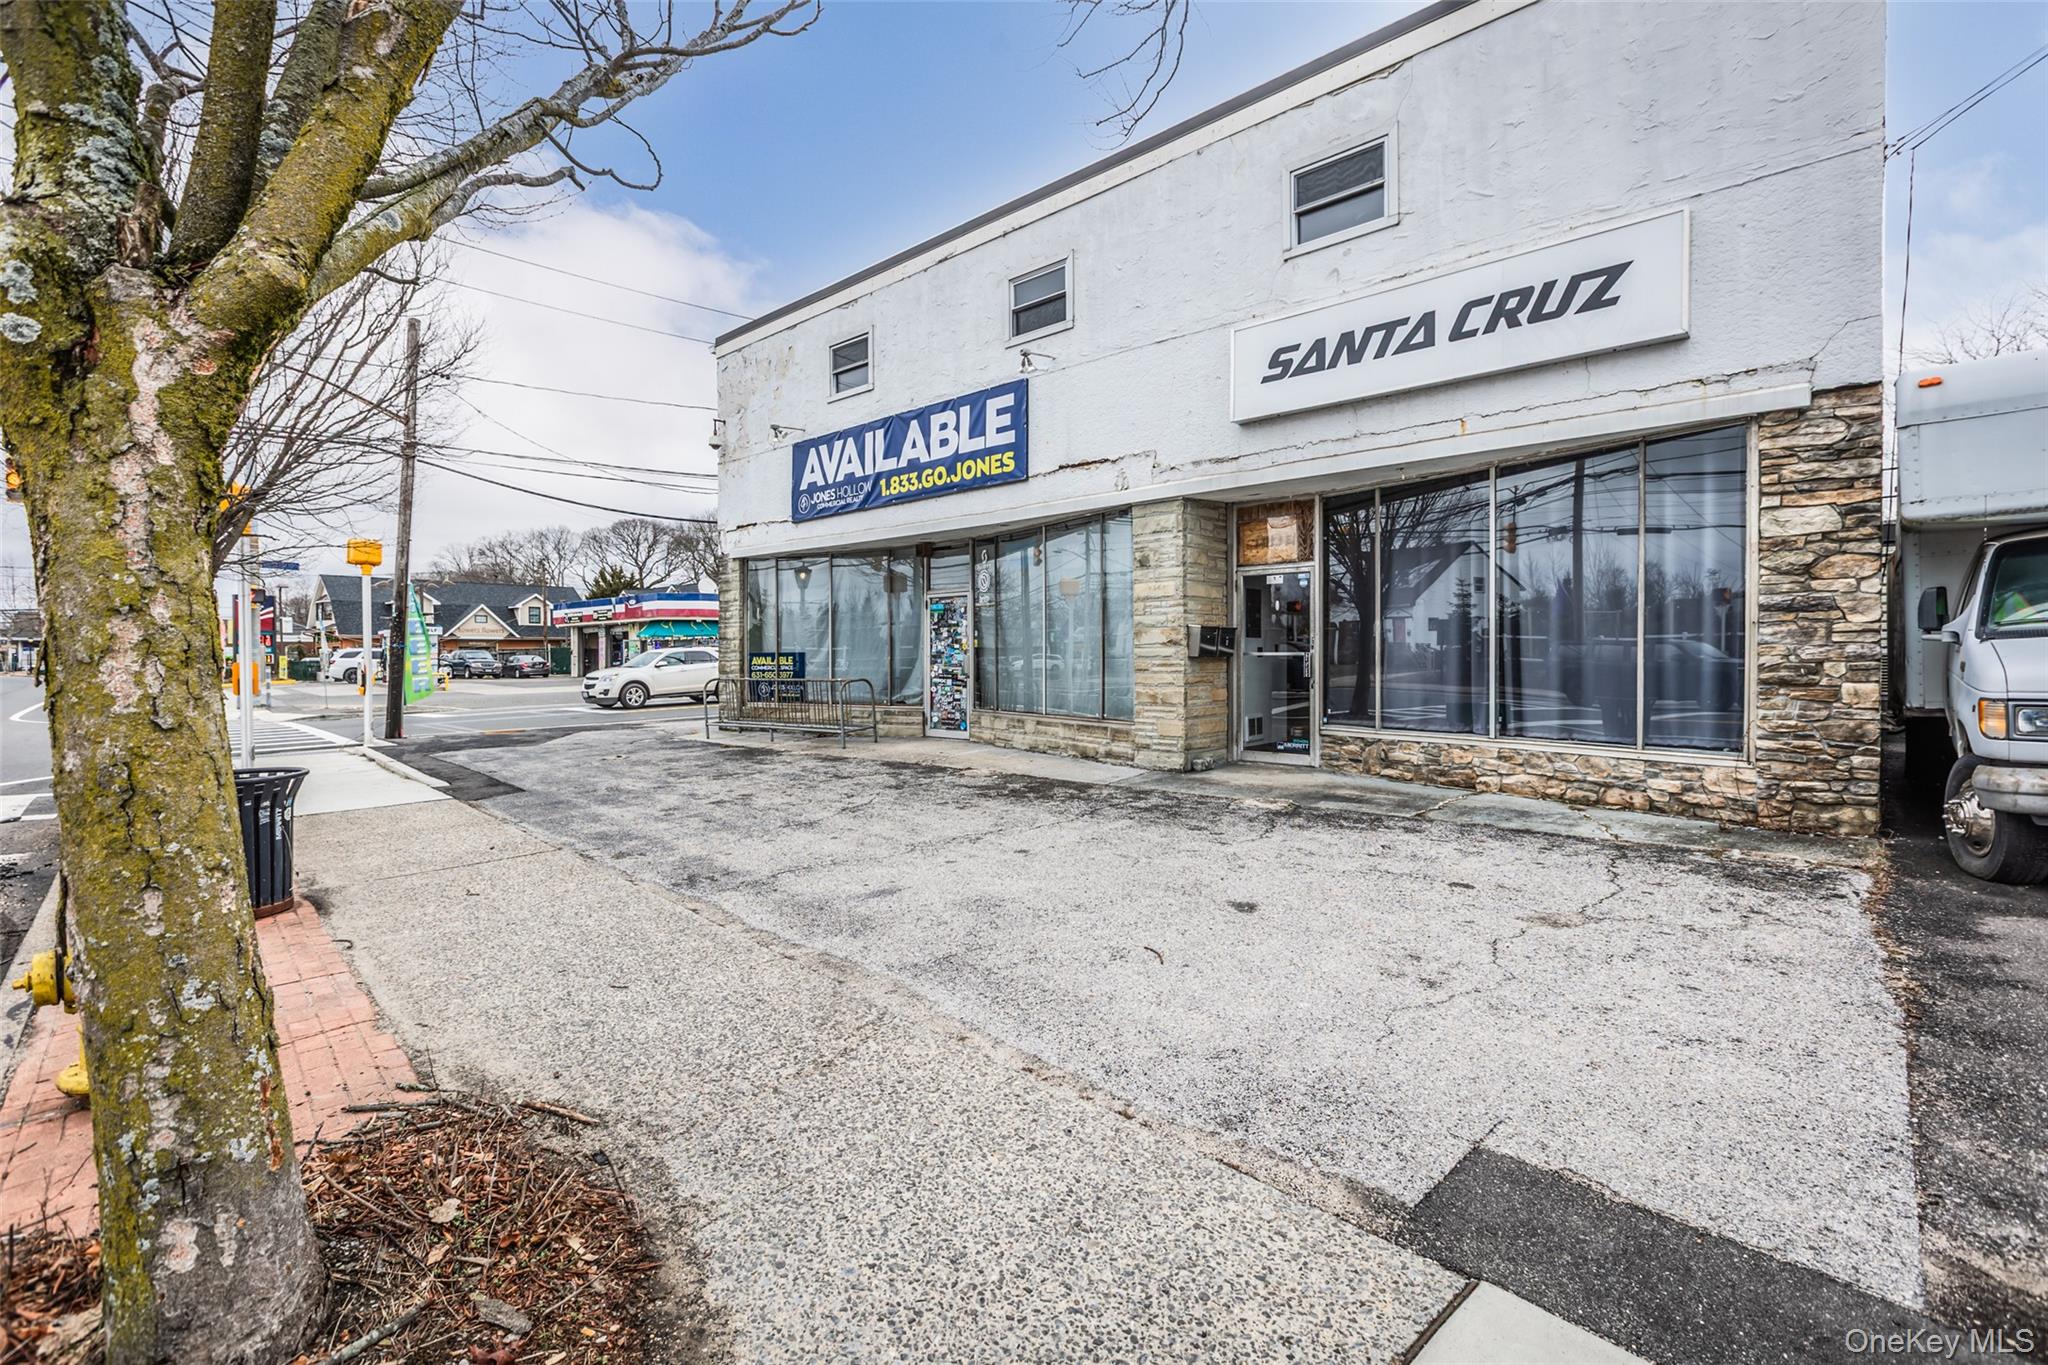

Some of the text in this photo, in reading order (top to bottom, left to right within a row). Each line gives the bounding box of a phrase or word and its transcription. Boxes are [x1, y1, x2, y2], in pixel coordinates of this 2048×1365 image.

[1260, 260, 1635, 384] SANTA CRUZ
[800, 393, 1015, 490] AVAILABLE
[811, 480, 873, 504] JONES HOLLOW
[879, 451, 1015, 497] 1.833.GO.JONES
[816, 499, 846, 510] COMMERCIAL
